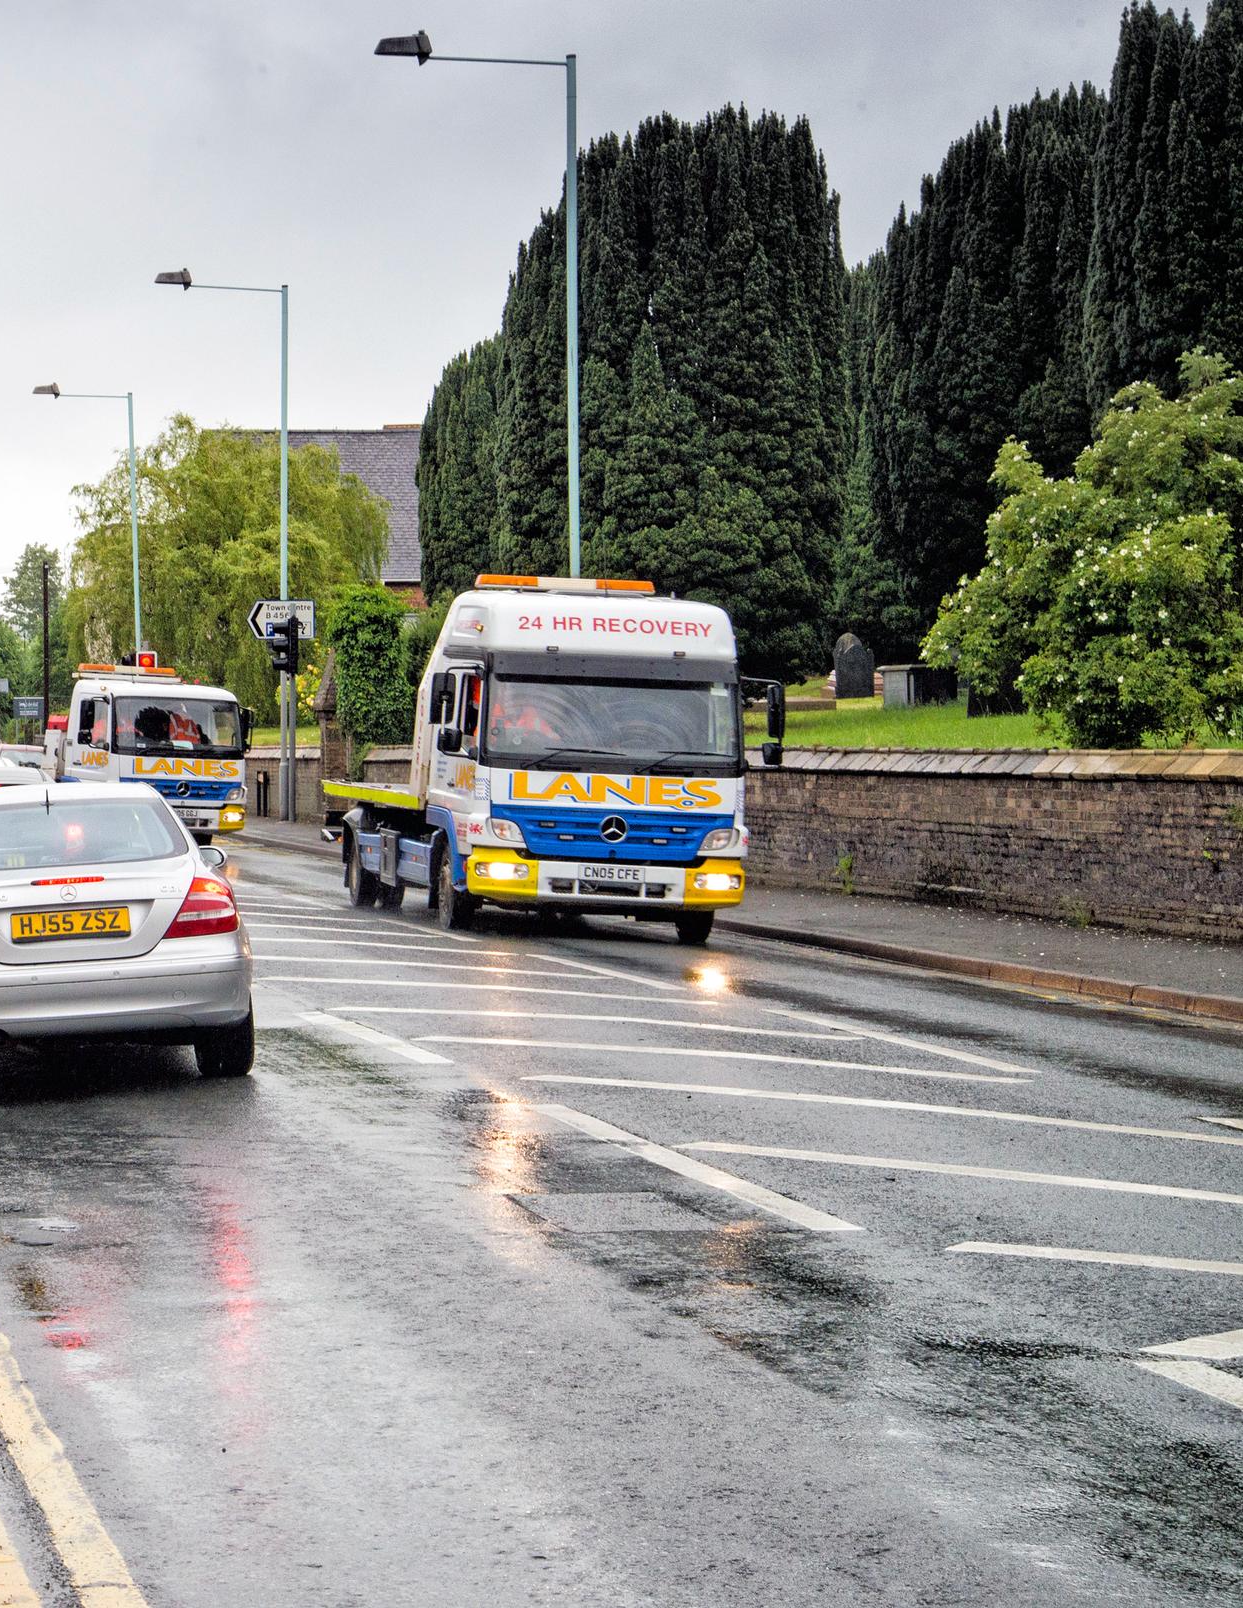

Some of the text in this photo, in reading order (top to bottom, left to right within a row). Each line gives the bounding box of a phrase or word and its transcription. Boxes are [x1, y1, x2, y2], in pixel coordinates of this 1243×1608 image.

[518, 616, 712, 637] 24 HR RECOVERY
[82, 751, 109, 766] LANES
[133, 757, 239, 778] LANES
[510, 771, 722, 810] LANES
[584, 866, 640, 880] CN05 CFE
[20, 914, 74, 936] HJ55
